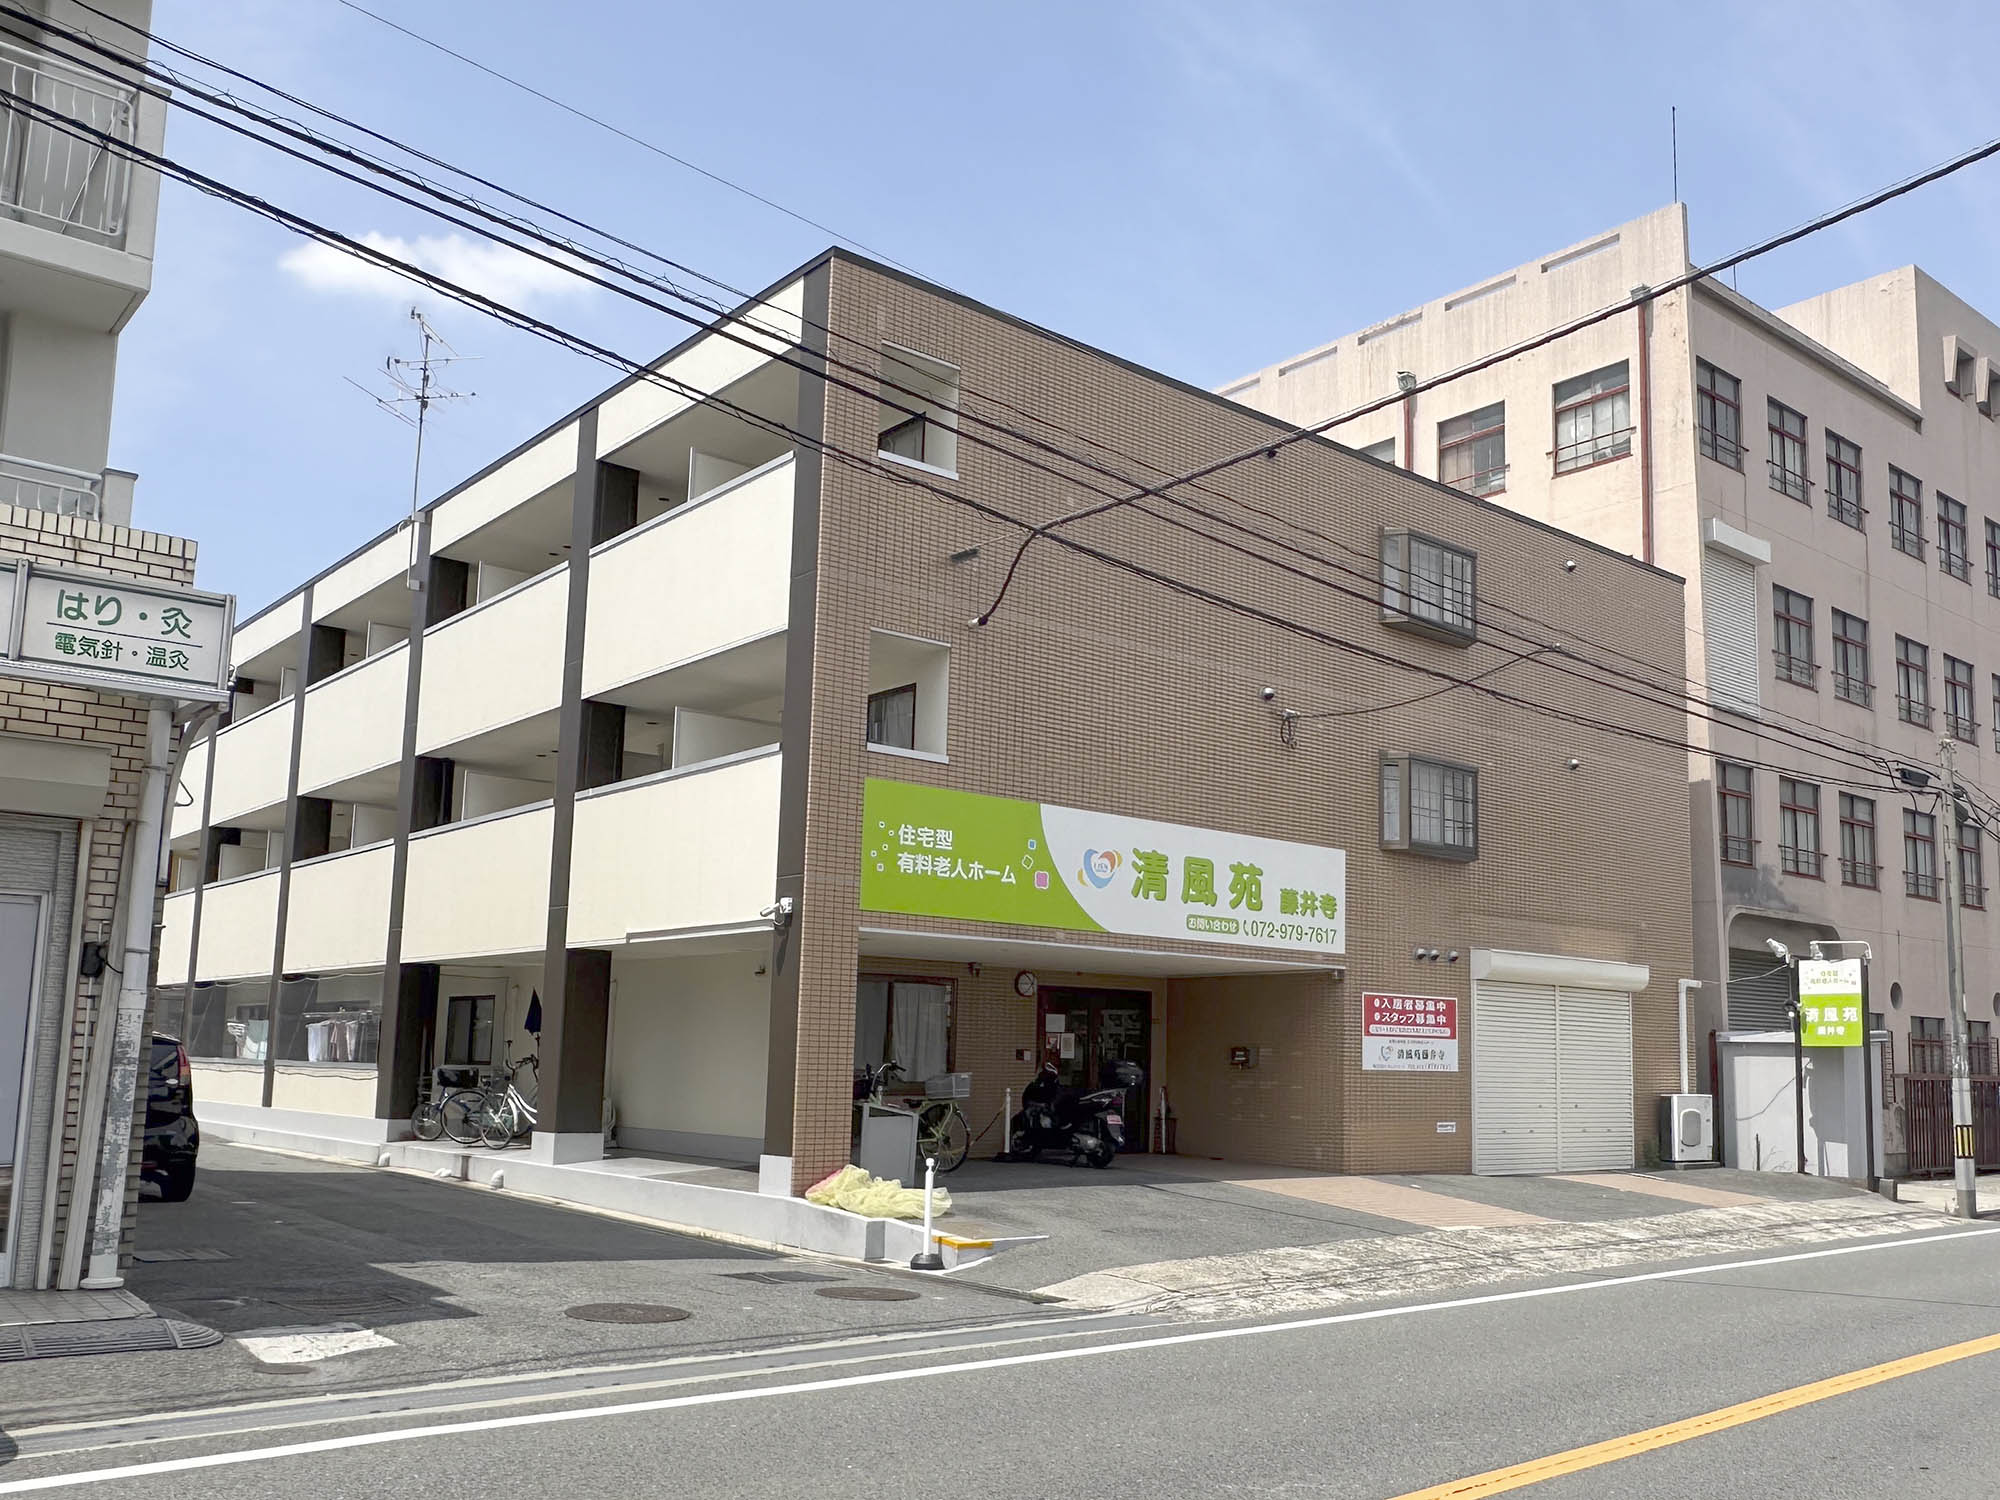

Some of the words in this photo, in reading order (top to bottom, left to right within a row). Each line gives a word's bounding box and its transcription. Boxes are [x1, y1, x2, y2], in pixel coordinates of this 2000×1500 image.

[57, 589, 193, 639] はり・灸
[55, 632, 190, 671] 電気針・温灸
[898, 824, 953, 850] 住宅型
[897, 852, 1016, 884] 有料老人ホーム
[1131, 848, 1263, 911] 清風苑
[1251, 920, 1337, 944] 072-979-7617
